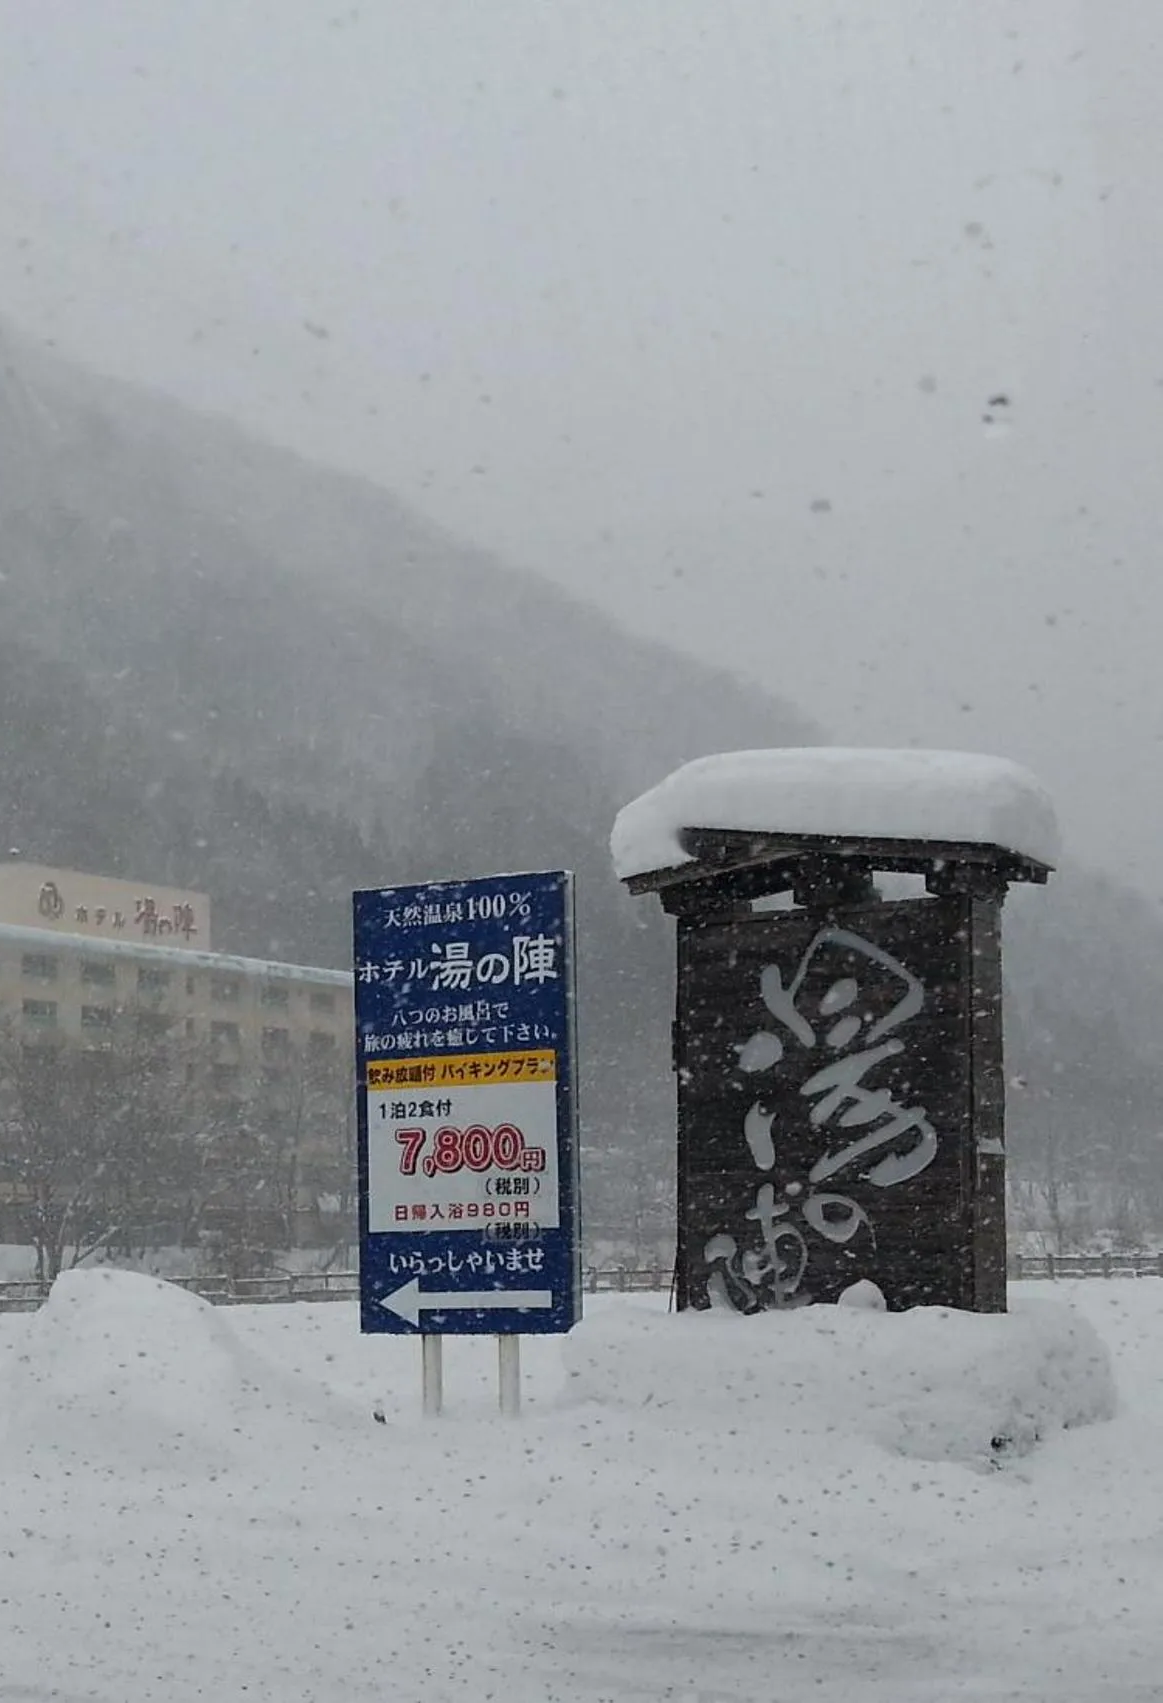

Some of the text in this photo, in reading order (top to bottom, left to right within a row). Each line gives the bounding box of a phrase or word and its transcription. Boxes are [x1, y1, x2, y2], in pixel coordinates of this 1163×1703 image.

[385, 891, 532, 928] 天然温泉100%
[358, 933, 558, 990] ホテル湯の陣
[391, 1001, 510, 1027] 八つのお風呂で
[379, 1099, 452, 1119] 1泊2食付
[395, 1123, 545, 1177] 7,800円
[389, 1248, 545, 1276] いらっしゃいませ
